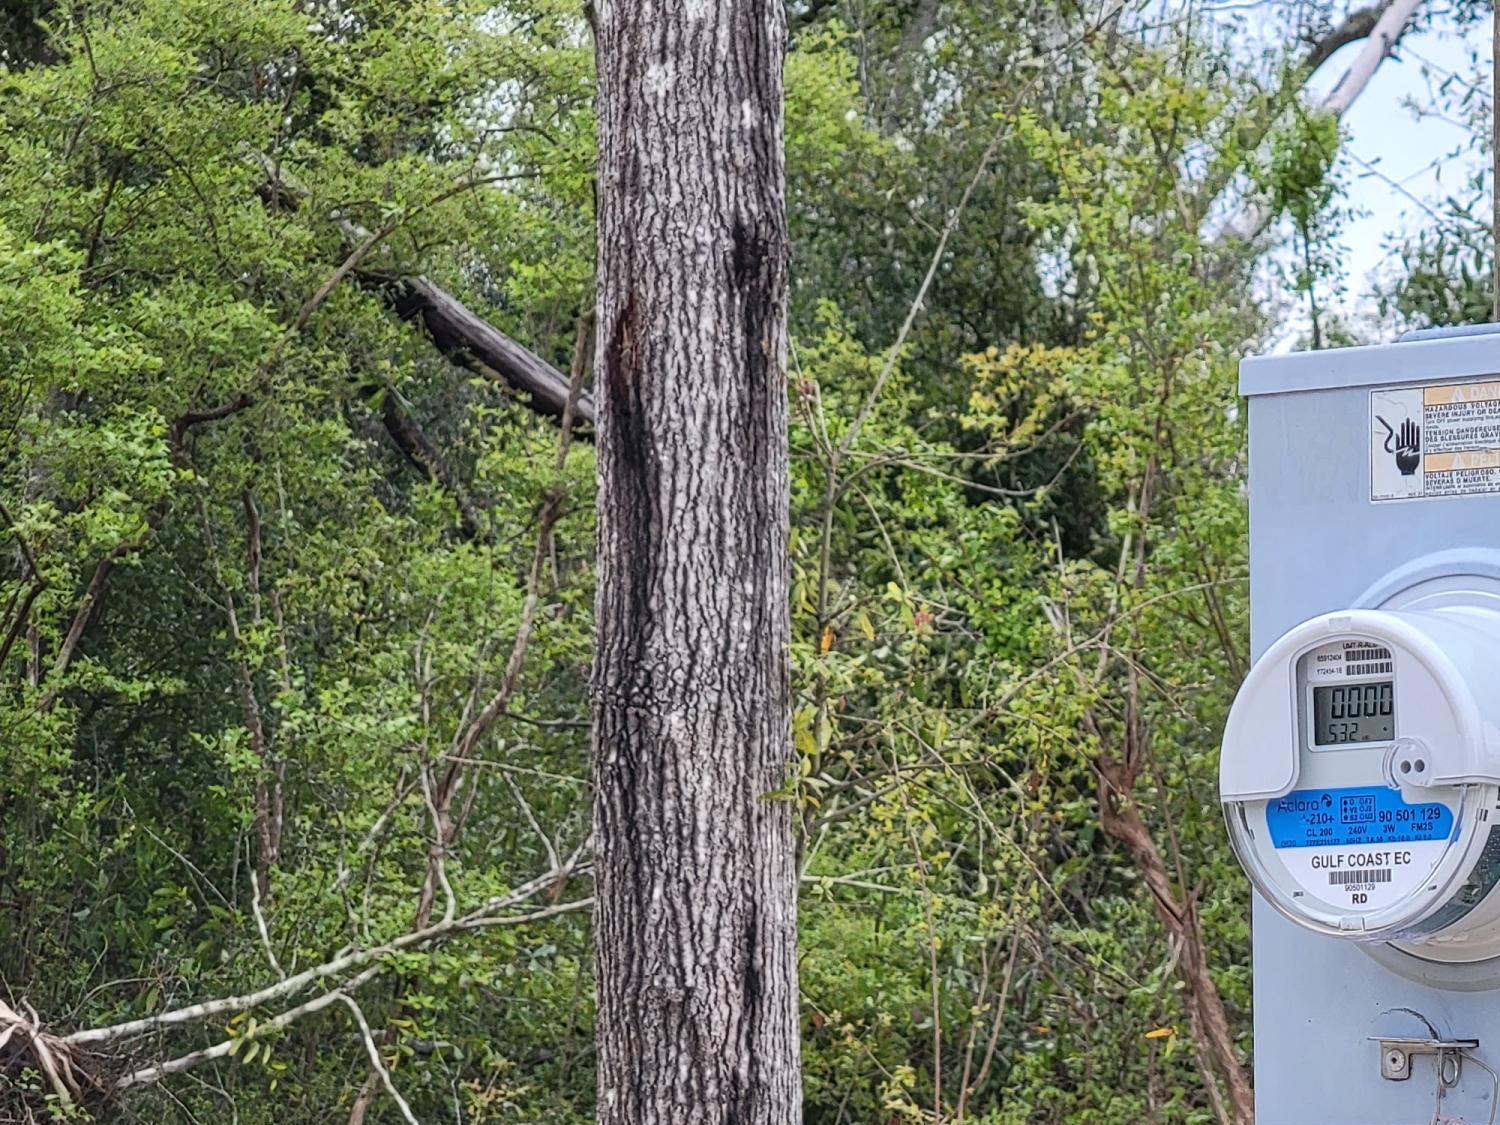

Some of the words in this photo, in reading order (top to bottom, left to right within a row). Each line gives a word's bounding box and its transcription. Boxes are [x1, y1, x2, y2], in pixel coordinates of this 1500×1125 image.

[1425, 403, 1467, 412] HAZARDOUS
[1425, 411, 1450, 419] SEVERE
[1451, 409, 1475, 417] INJURY
[1425, 429, 1453, 437] TENSION
[1329, 722, 1359, 742] 532
[1277, 797, 1319, 813] Aclara
[1379, 810, 1392, 823] 90
[1396, 809, 1416, 822] 501
[1421, 807, 1441, 820] 129
[1306, 829, 1316, 837] CL
[1320, 828, 1333, 836] 200
[1348, 826, 1367, 835] 240V
[1383, 824, 1396, 833] 3W
[1411, 822, 1433, 831] FM2S
[1311, 854, 1345, 869] GULF
[1348, 852, 1391, 867] COAST
[1394, 851, 1411, 865] EC
[1345, 883, 1376, 892] 90501129
[1352, 893, 1368, 904] RD
